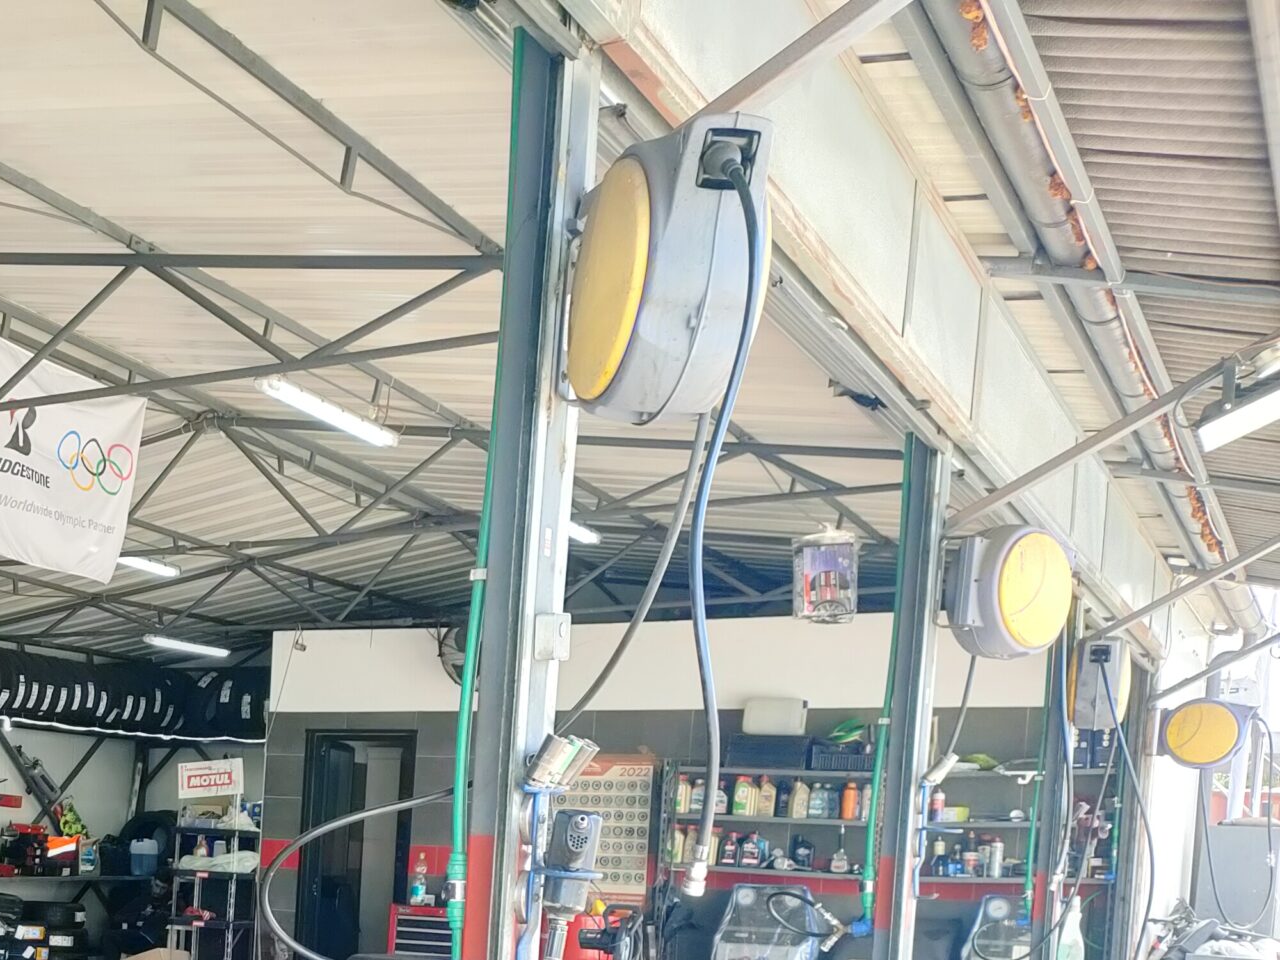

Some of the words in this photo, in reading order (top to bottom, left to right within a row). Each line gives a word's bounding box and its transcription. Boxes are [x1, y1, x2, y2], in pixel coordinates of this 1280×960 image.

[54, 510, 86, 530] Olympic
[619, 767, 651, 777] 2022
[189, 773, 230, 787] MOTUL
